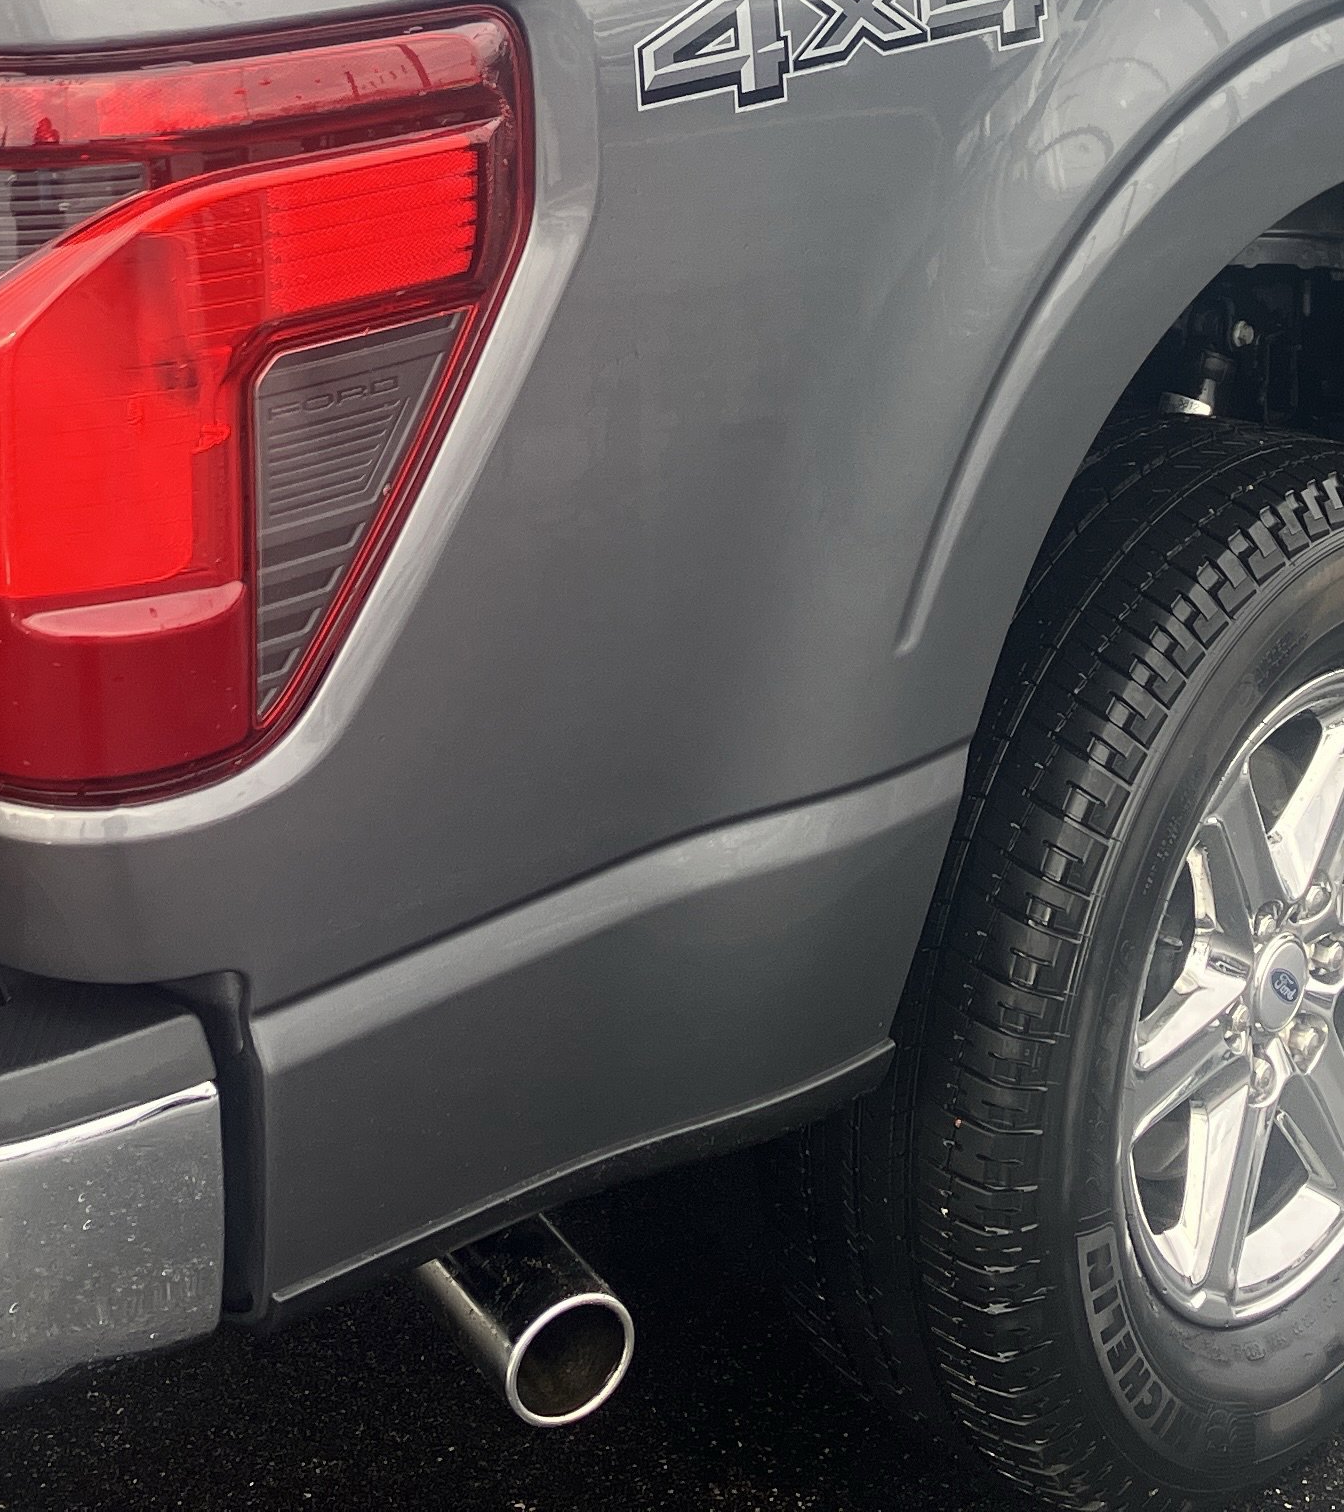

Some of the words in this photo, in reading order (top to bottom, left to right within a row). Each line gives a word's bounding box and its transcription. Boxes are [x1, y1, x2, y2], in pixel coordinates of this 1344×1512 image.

[267, 375, 400, 424] FORD
[1274, 973, 1297, 1001] Ford
[1086, 1242, 1201, 1442] ICHELIN
